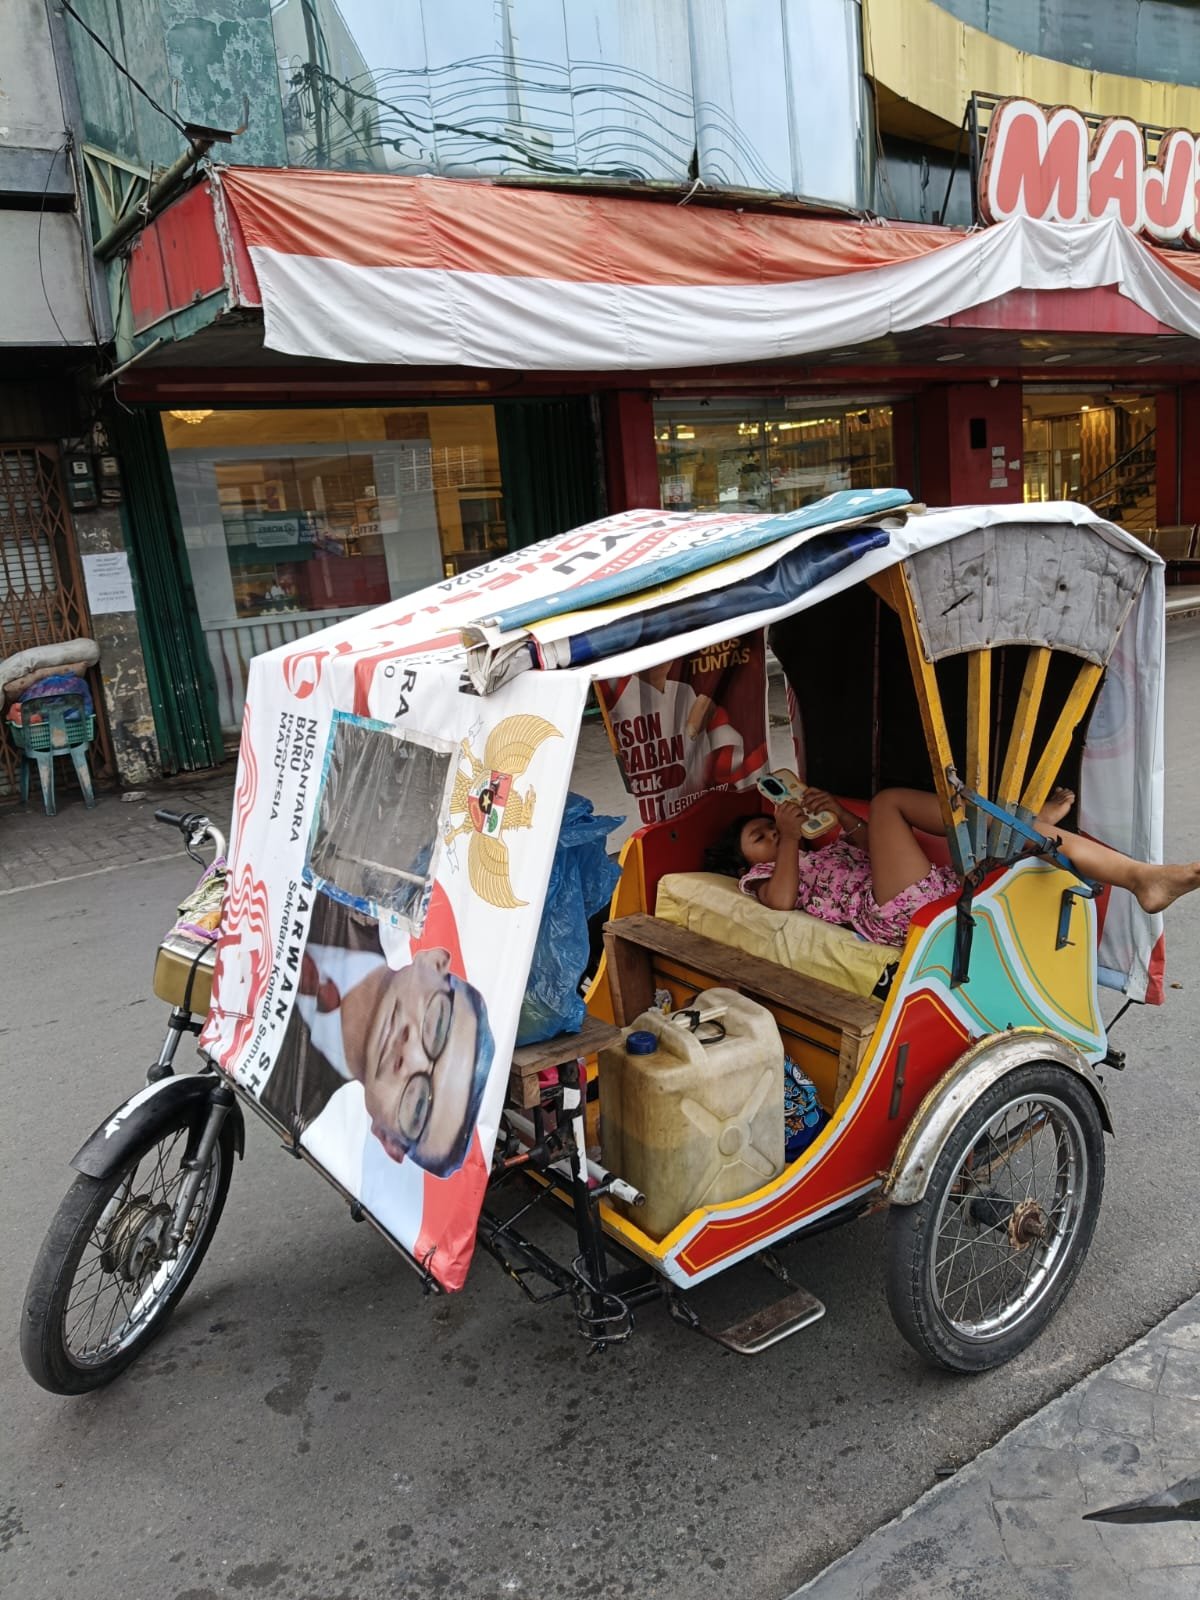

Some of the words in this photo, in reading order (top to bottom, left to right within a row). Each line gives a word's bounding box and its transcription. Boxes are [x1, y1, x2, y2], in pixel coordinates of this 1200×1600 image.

[980, 97, 1200, 244] MAJ
[437, 563, 499, 592] 2024
[689, 647, 750, 676] TUNTAS
[270, 714, 294, 820] INDONESIA
[273, 712, 288, 768] MAJU
[289, 716, 307, 772] BARU
[289, 719, 318, 842] NUSANTARA
[274, 880, 298, 959] Sekretaris
[261, 963, 281, 1022] Komda
[239, 1024, 267, 1074] Sumut
